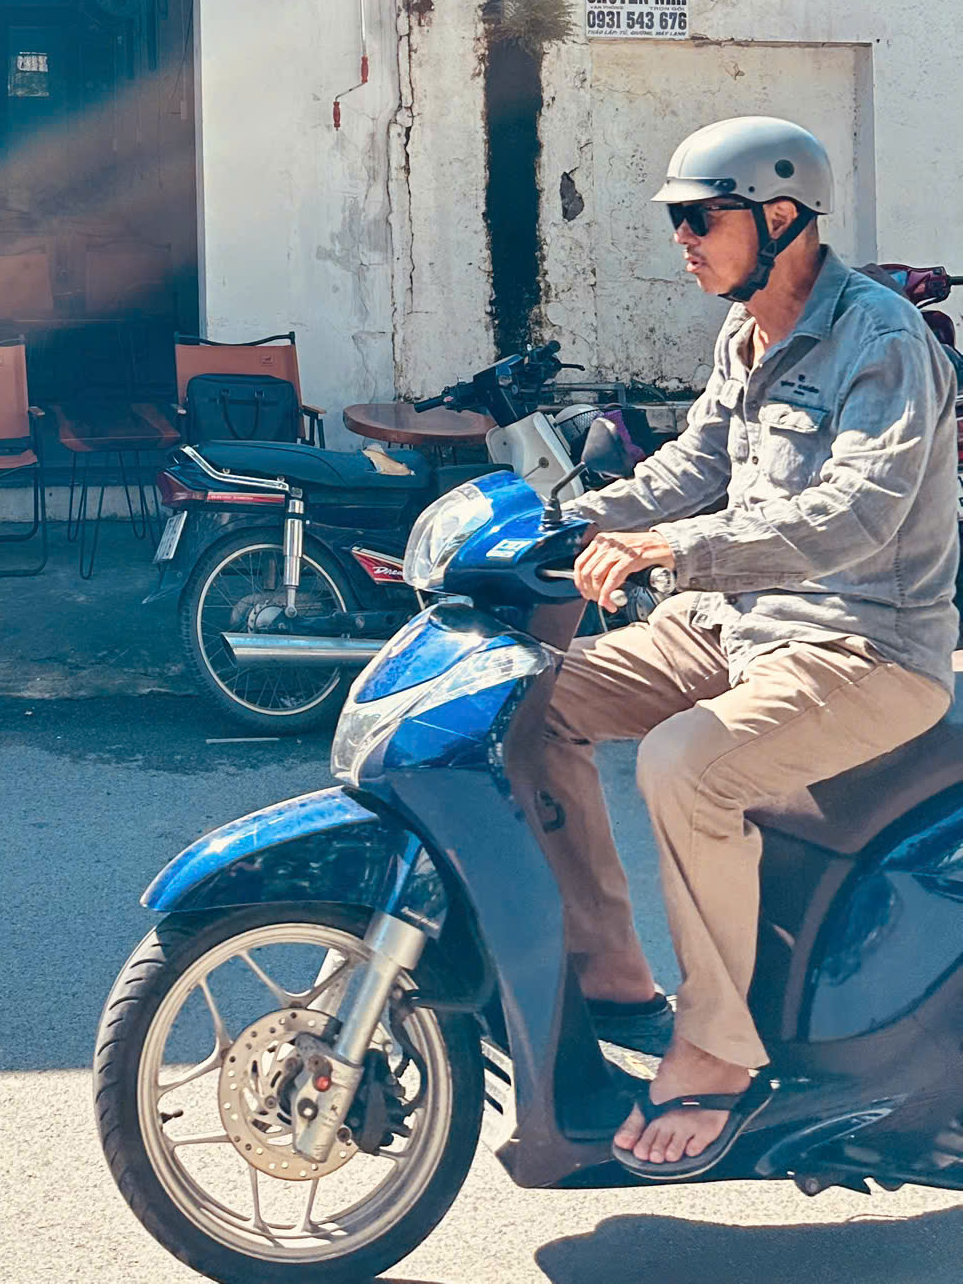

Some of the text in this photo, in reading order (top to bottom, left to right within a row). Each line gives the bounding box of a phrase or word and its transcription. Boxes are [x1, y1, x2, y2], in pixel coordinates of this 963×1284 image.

[587, 10, 687, 30] 0931 543 676
[372, 566, 403, 576] Drea
